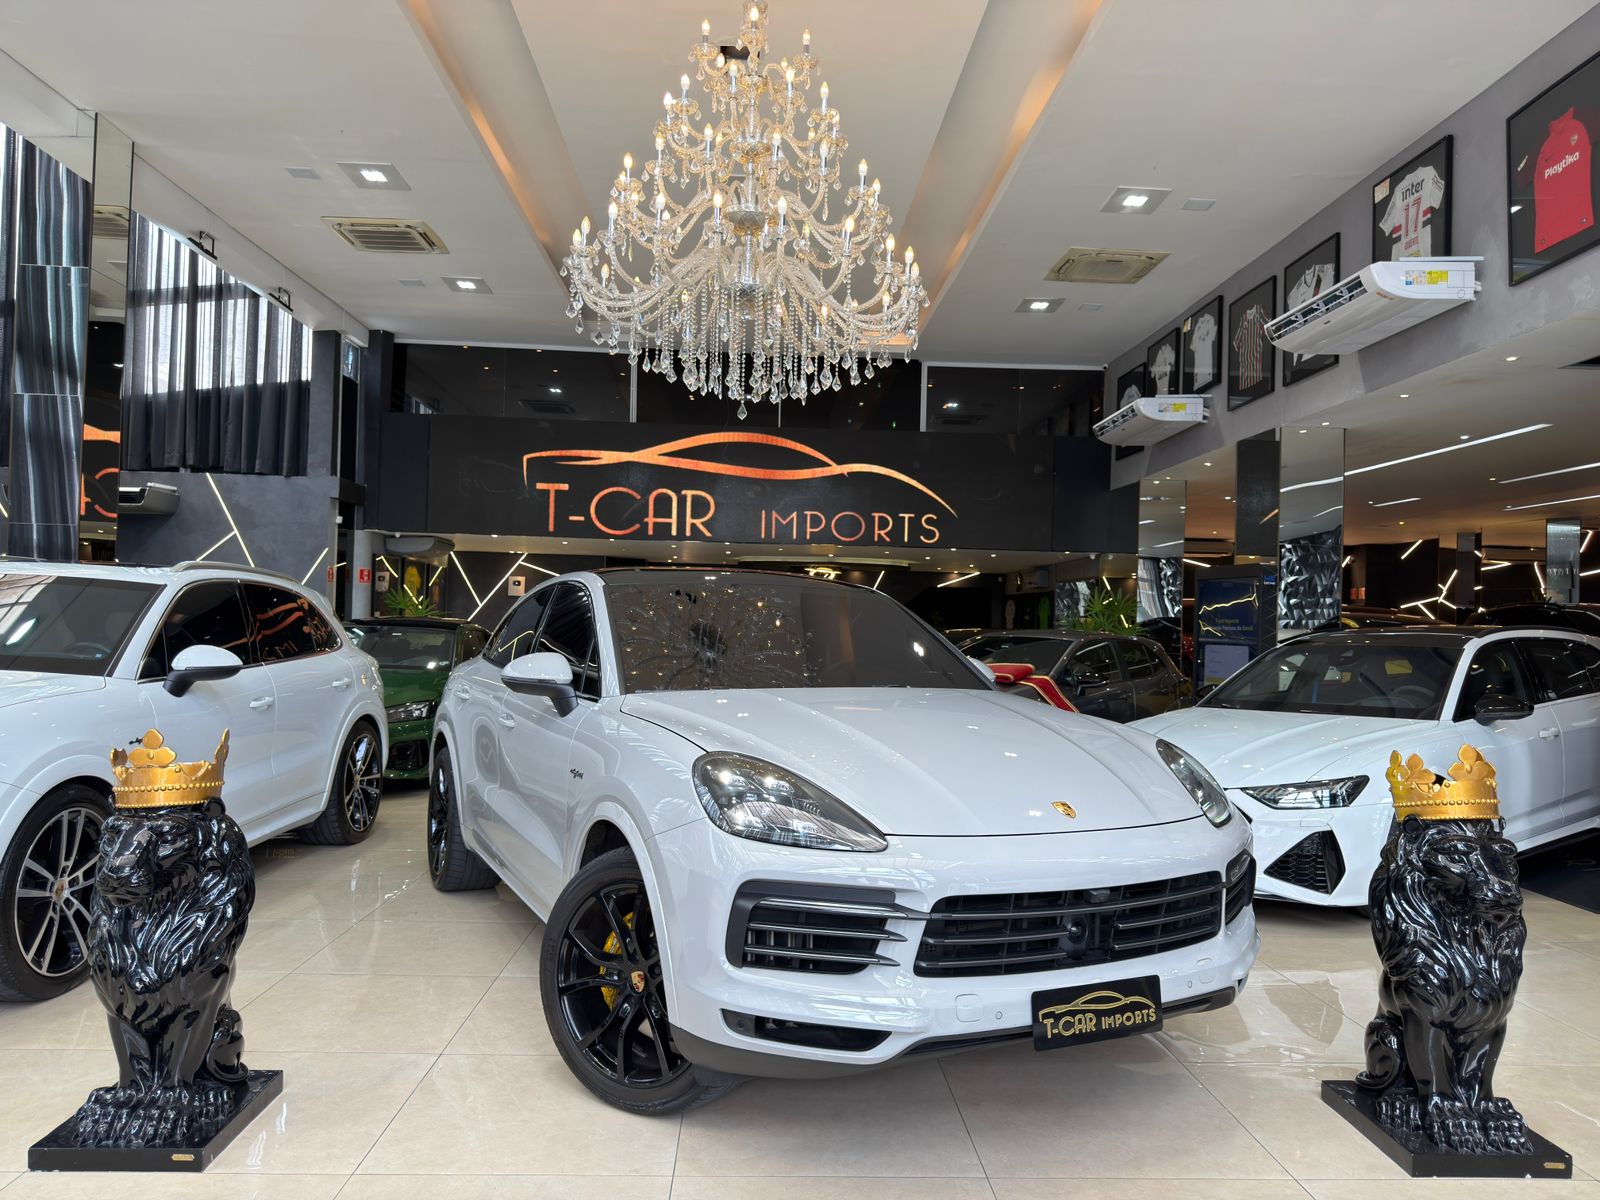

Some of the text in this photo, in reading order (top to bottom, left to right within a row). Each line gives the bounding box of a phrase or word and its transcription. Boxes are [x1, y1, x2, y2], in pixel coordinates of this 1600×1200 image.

[1401, 179, 1425, 202] inter
[1404, 196, 1422, 237] 17
[535, 482, 940, 544] T-CAR IMPORTS
[1043, 1008, 1157, 1039] T-CAR IMPORTS
